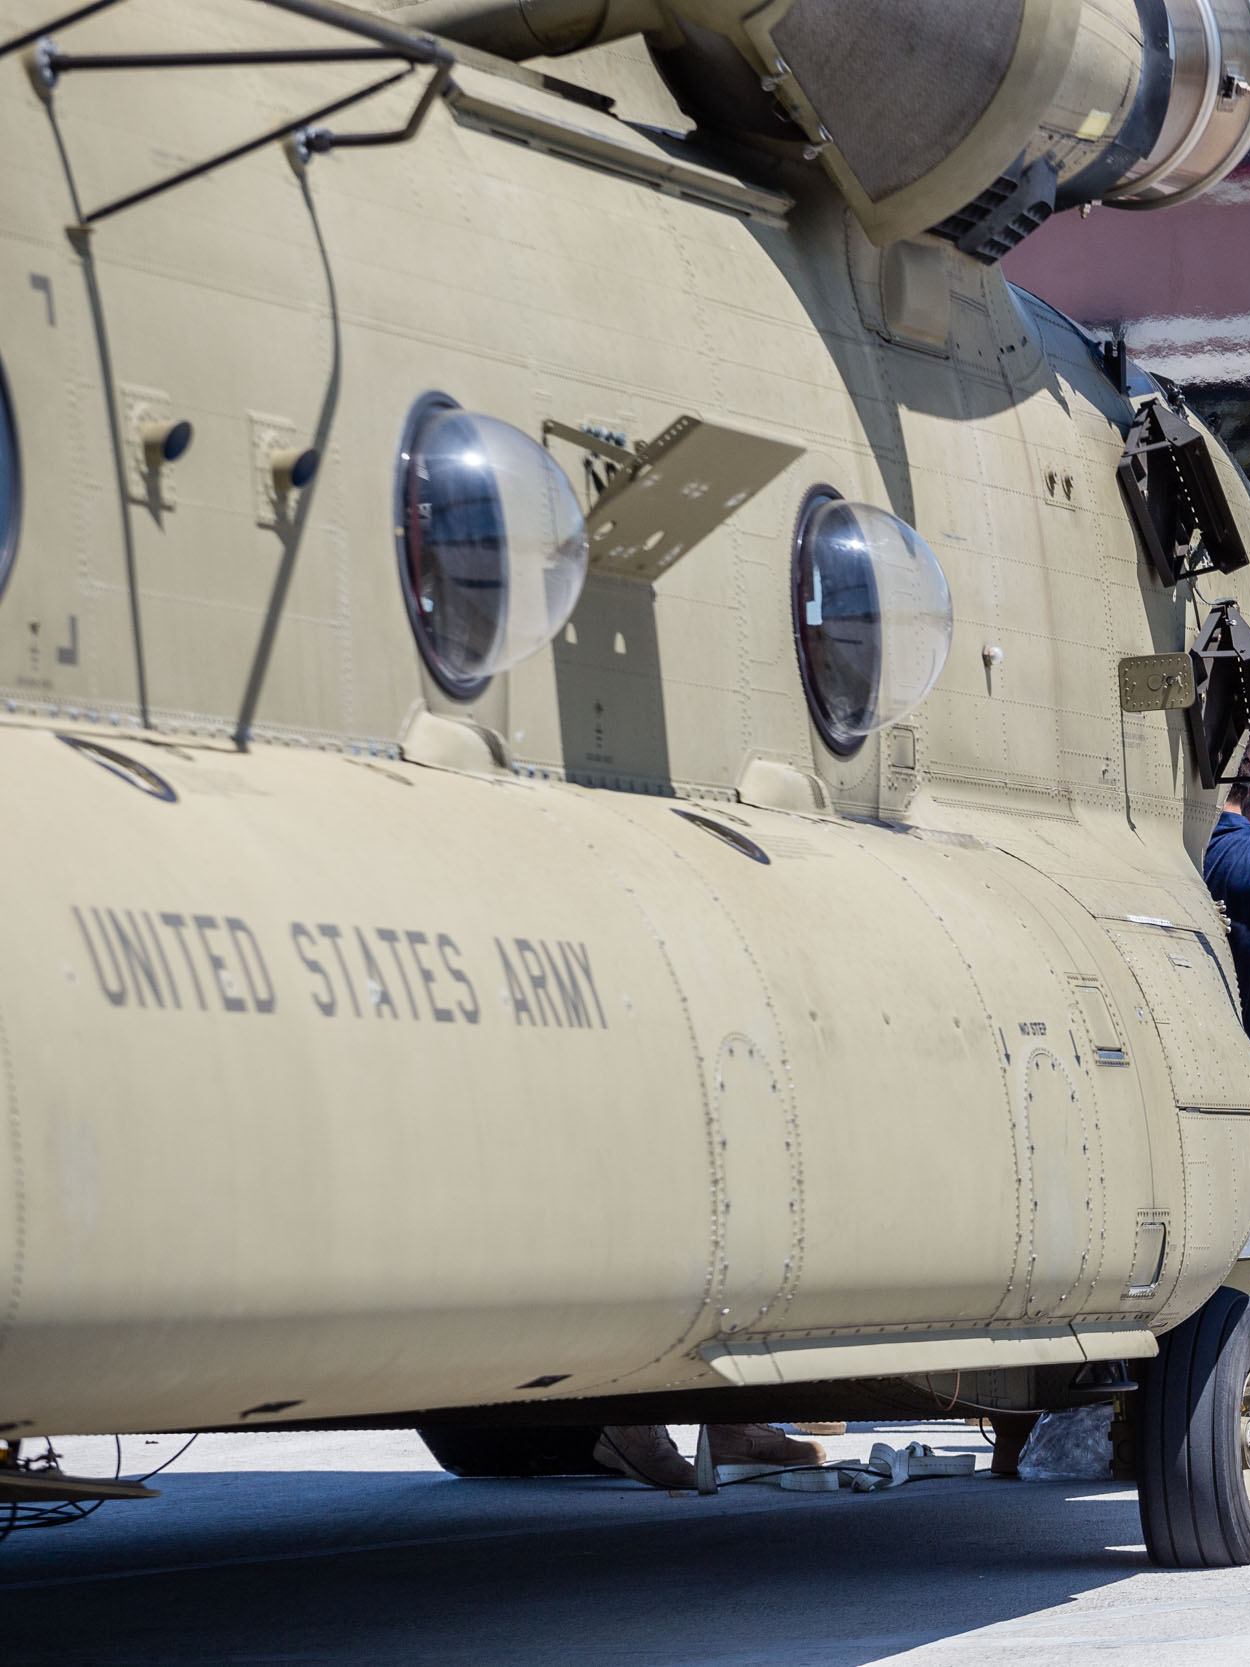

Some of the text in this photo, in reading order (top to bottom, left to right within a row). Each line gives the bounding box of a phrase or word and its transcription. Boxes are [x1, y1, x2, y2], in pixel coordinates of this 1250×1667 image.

[71, 905, 609, 1030] UNITED STATES ARMY
[1017, 1022, 1047, 1036] NO STEP
